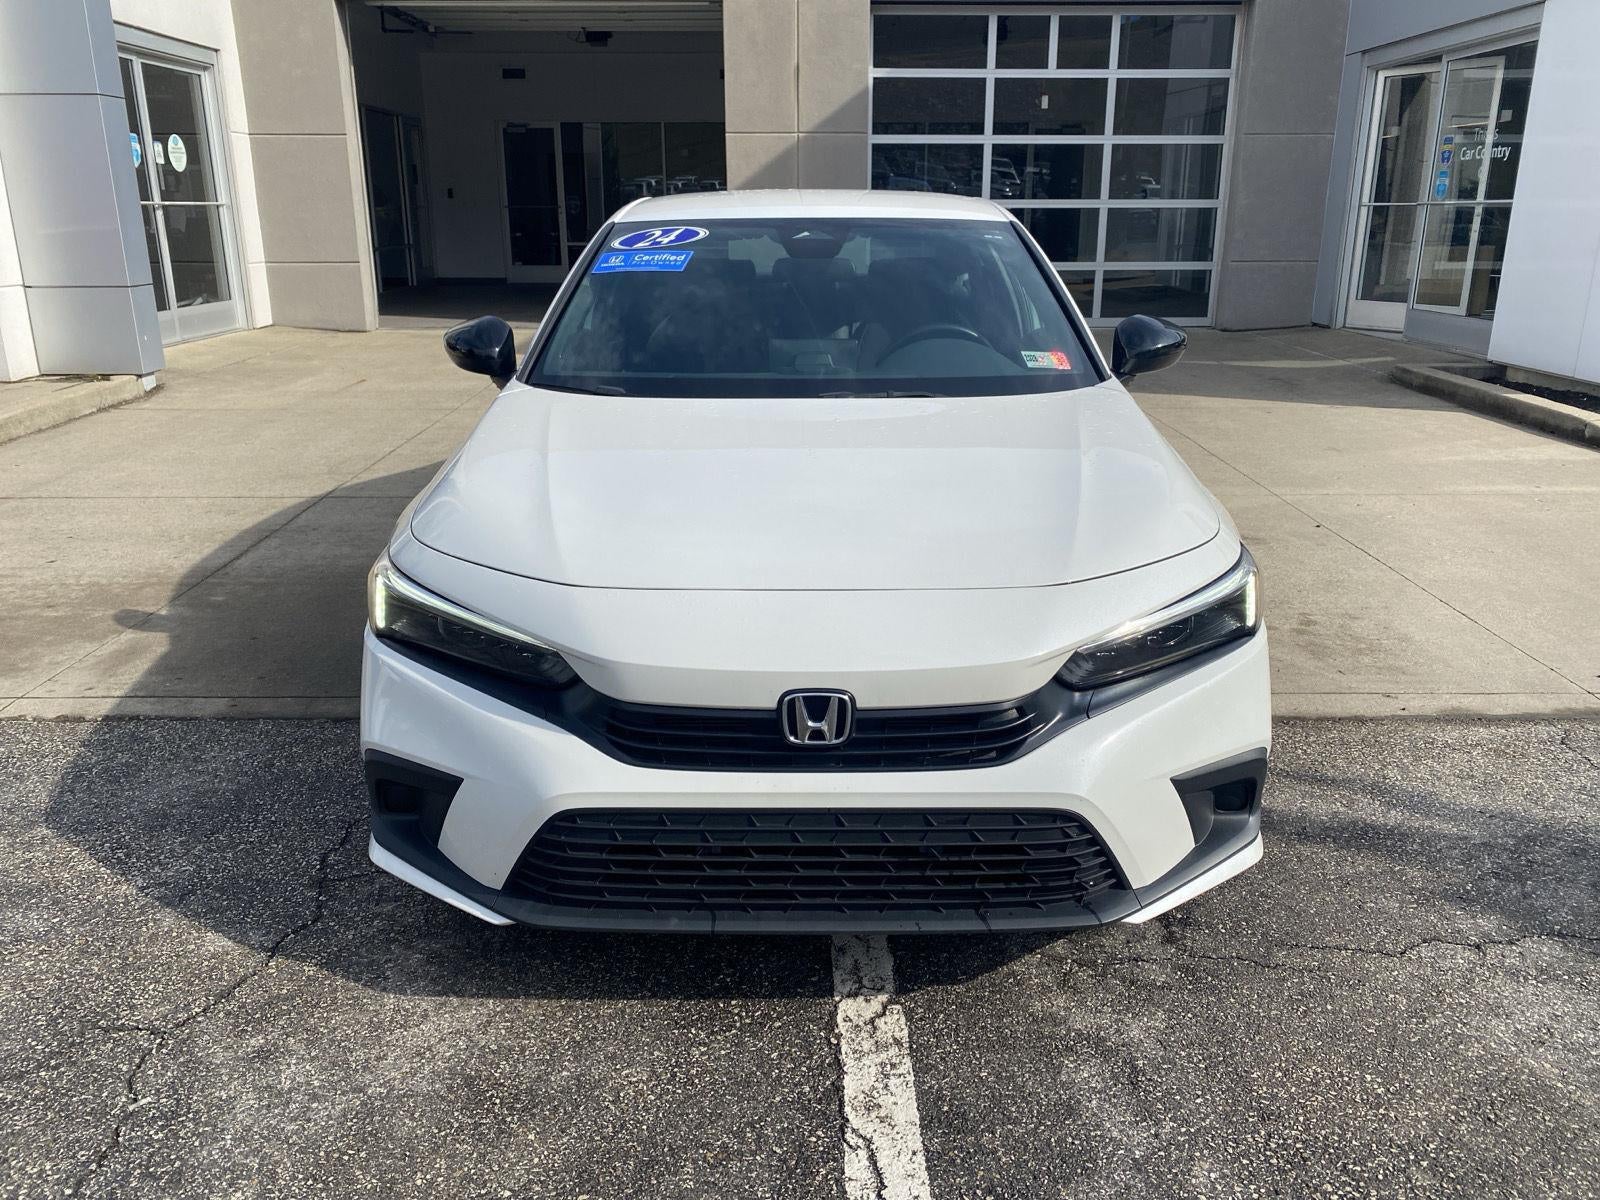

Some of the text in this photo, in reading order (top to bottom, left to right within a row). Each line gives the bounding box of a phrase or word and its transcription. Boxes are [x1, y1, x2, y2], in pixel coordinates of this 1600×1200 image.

[1460, 147, 1474, 160] Car
[1475, 145, 1511, 161] Contry
[632, 227, 687, 248] 24
